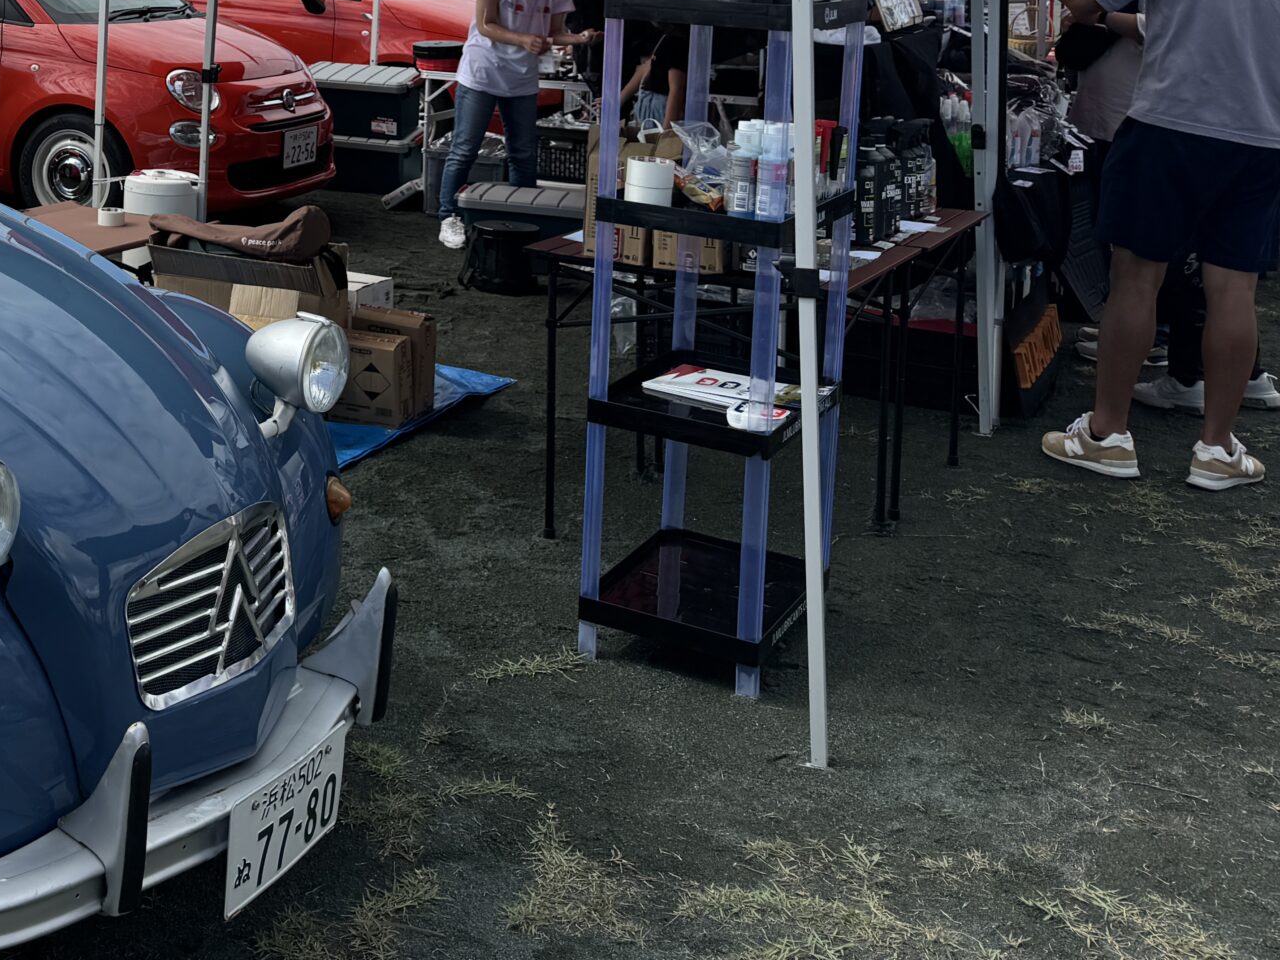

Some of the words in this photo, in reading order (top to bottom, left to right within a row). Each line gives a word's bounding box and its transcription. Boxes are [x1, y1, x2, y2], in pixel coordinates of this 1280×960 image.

[234, 858, 251, 890] ぬ
[256, 772, 337, 888] 77-80
[260, 748, 324, 821] 浜松502
